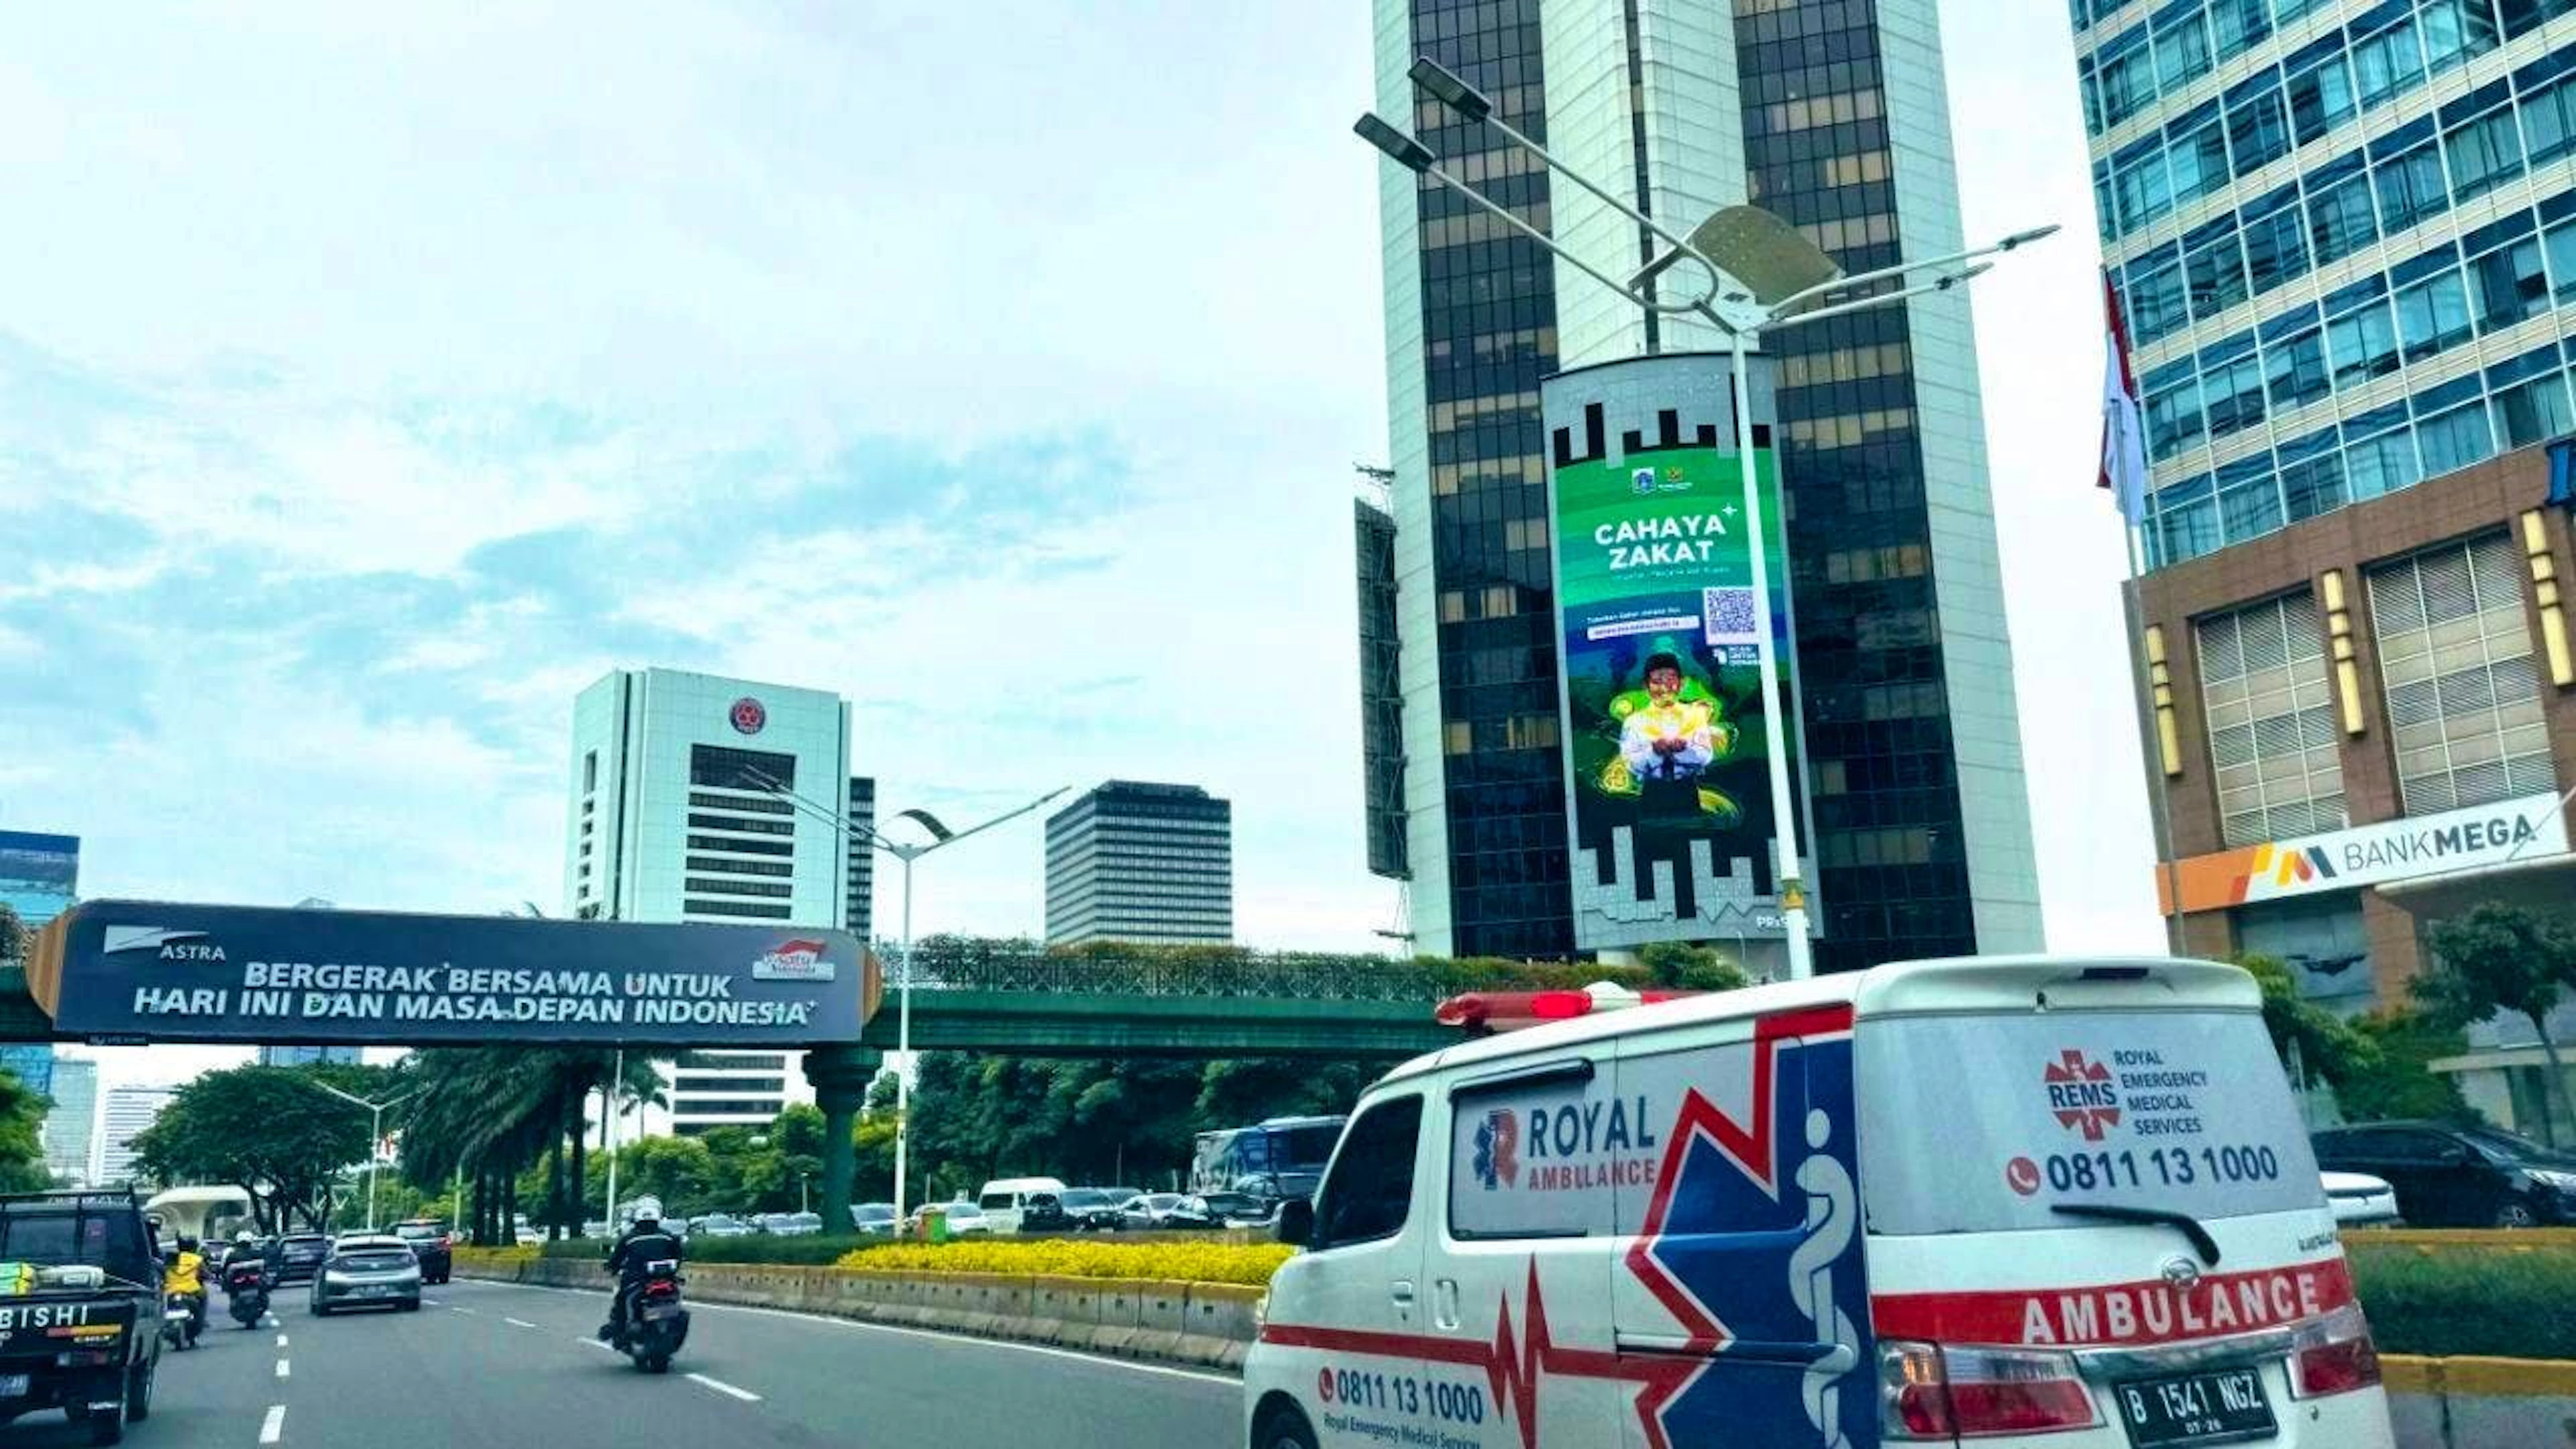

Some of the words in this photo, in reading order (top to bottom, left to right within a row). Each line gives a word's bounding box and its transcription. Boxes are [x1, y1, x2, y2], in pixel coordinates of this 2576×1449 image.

[1595, 515, 1725, 545] CAHAYA
[1609, 541, 1713, 570] ZAKAT
[161, 944, 225, 961] ASTRA
[244, 963, 435, 991] BERGERAK
[447, 968, 612, 997] BERSAMA
[625, 973, 733, 998] UNTUK
[134, 988, 227, 1016] HARI
[239, 990, 290, 1017] INI
[302, 991, 383, 1019] DAN
[394, 995, 500, 1020] MASA
[514, 997, 624, 1022] DEPAN
[635, 1000, 809, 1025] INDONESIA
[2114, 1051, 2163, 1065] ROYAL
[2121, 1071, 2207, 1088] EMERGENCY
[2048, 1083, 2117, 1108] REMS
[2127, 1095, 2194, 1112] MEDICAL
[1530, 1096, 1655, 1157] ROYAL
[2134, 1118, 2202, 1135] SERVICES
[1529, 1159, 1656, 1190] AMBULANCE
[2047, 1150, 2140, 1191] 0811
[2151, 1148, 2194, 1185] 13
[2202, 1145, 2277, 1182] 1000
[0, 1305, 88, 1330] BISHI
[2022, 1273, 2320, 1344] AMBULANCE
[1337, 1369, 1385, 1408] 0811
[1393, 1377, 1418, 1413] 13
[1425, 1382, 1482, 1424] 1000
[2128, 1390, 2147, 1424] B
[2158, 1381, 2210, 1419] 1541
[2218, 1375, 2263, 1411] NGZ
[1324, 1412, 1348, 1433] Royal
[1350, 1417, 1398, 1443] Emergency
[1401, 1426, 1437, 1447] Medical
